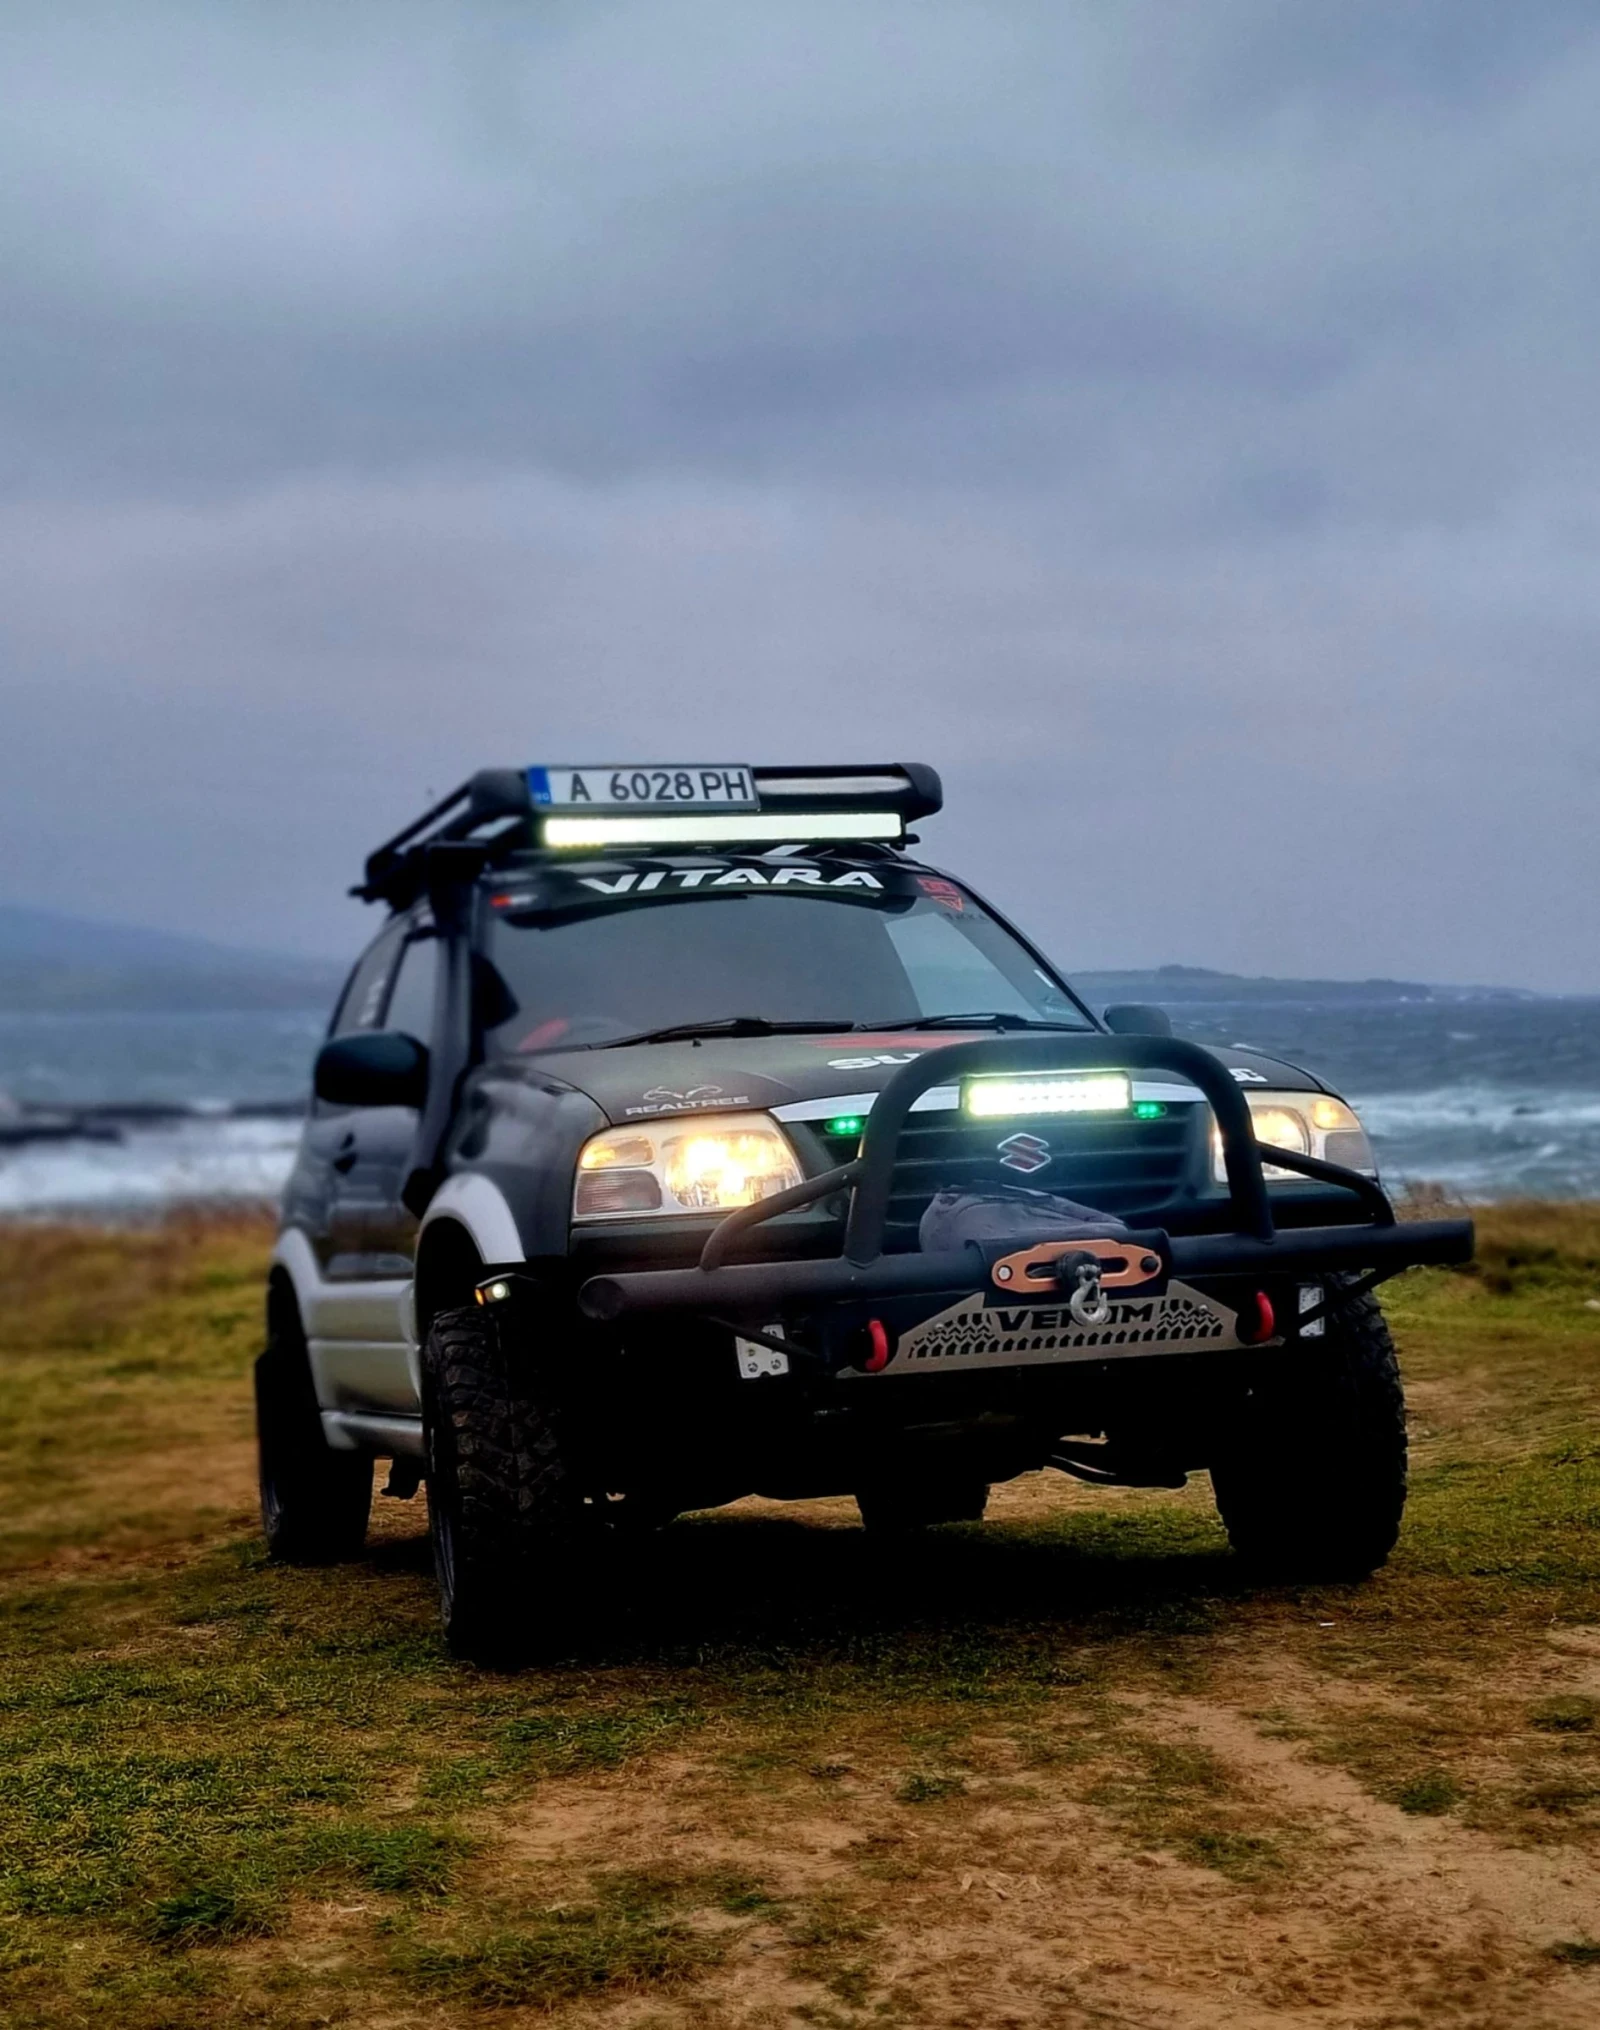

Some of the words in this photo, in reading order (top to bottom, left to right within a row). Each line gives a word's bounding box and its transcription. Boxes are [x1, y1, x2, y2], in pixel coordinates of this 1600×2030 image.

[571, 773, 592, 801] A
[610, 772, 695, 800] 6028
[700, 772, 748, 799] PH
[577, 868, 885, 894] VITARA
[626, 1096, 749, 1115] REALTREE
